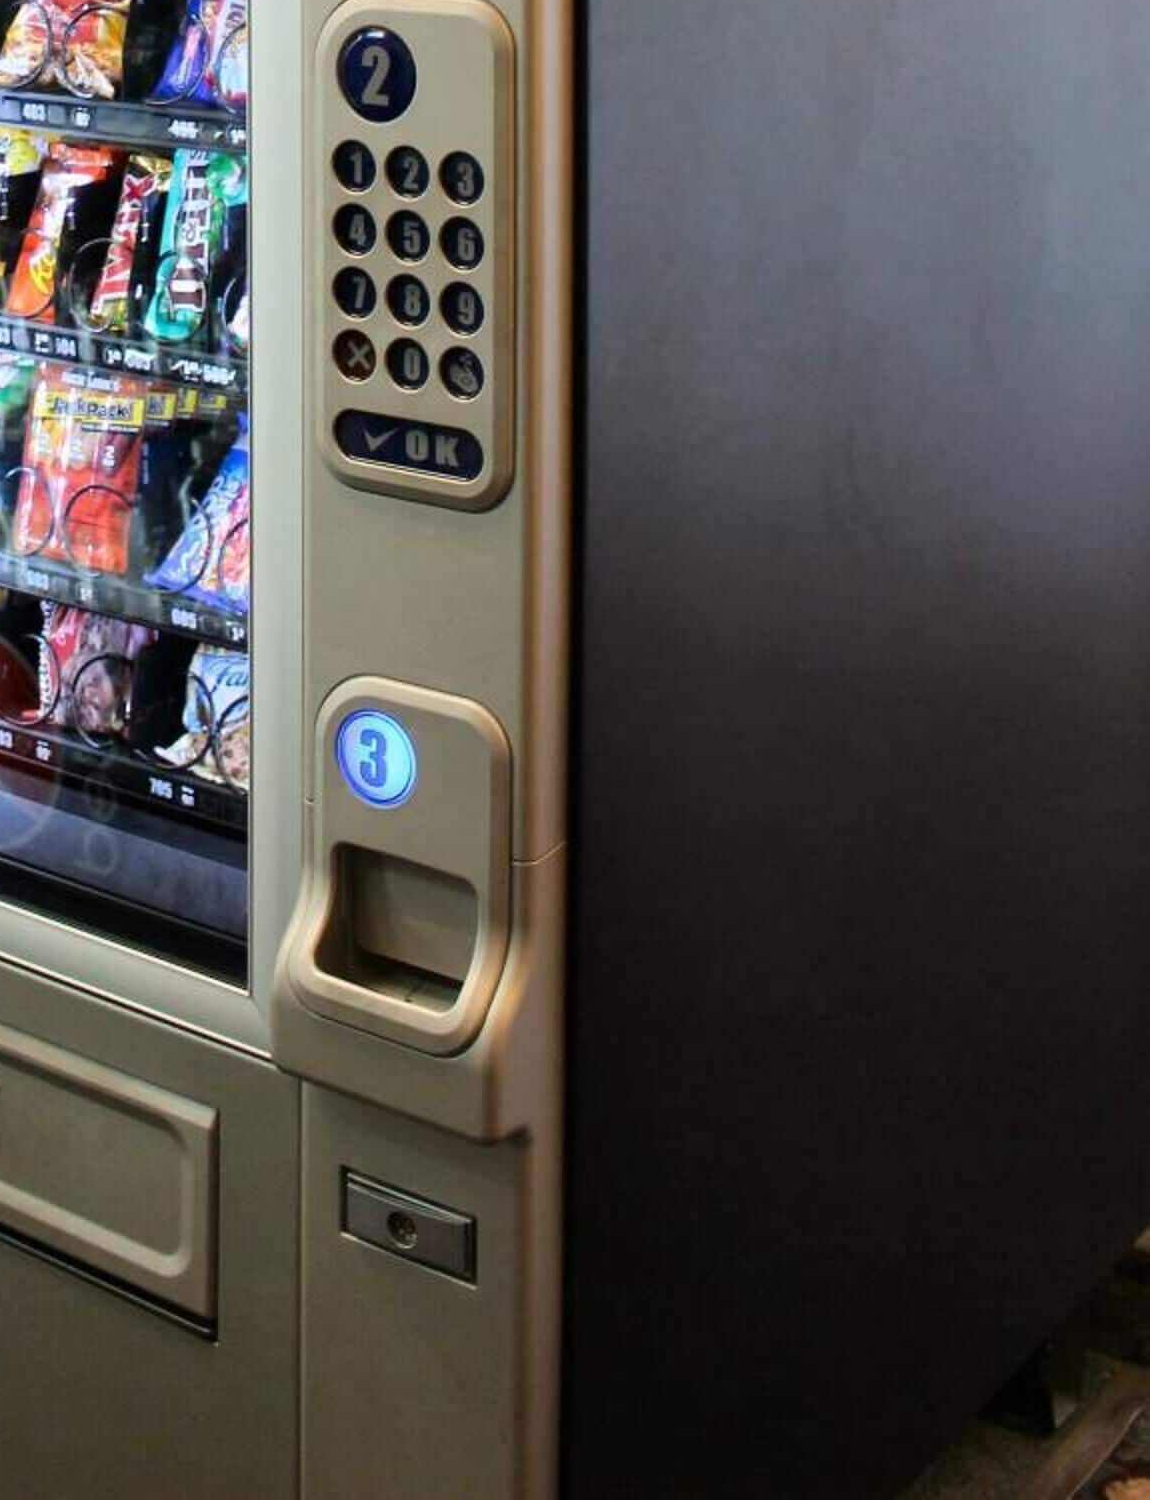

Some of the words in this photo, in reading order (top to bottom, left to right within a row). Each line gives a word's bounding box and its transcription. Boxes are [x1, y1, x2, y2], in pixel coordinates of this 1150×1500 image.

[360, 45, 391, 106] 2
[349, 150, 363, 184] 1
[402, 156, 420, 193] 2
[456, 161, 475, 199] 3
[348, 213, 367, 247] 4
[402, 219, 421, 255] 5
[456, 226, 476, 262] 6
[352, 276, 367, 310] 7
[402, 282, 421, 318] 8
[456, 289, 475, 327] 9
[403, 347, 420, 382] 0
[404, 428, 461, 467] OK
[359, 728, 387, 788] 3
